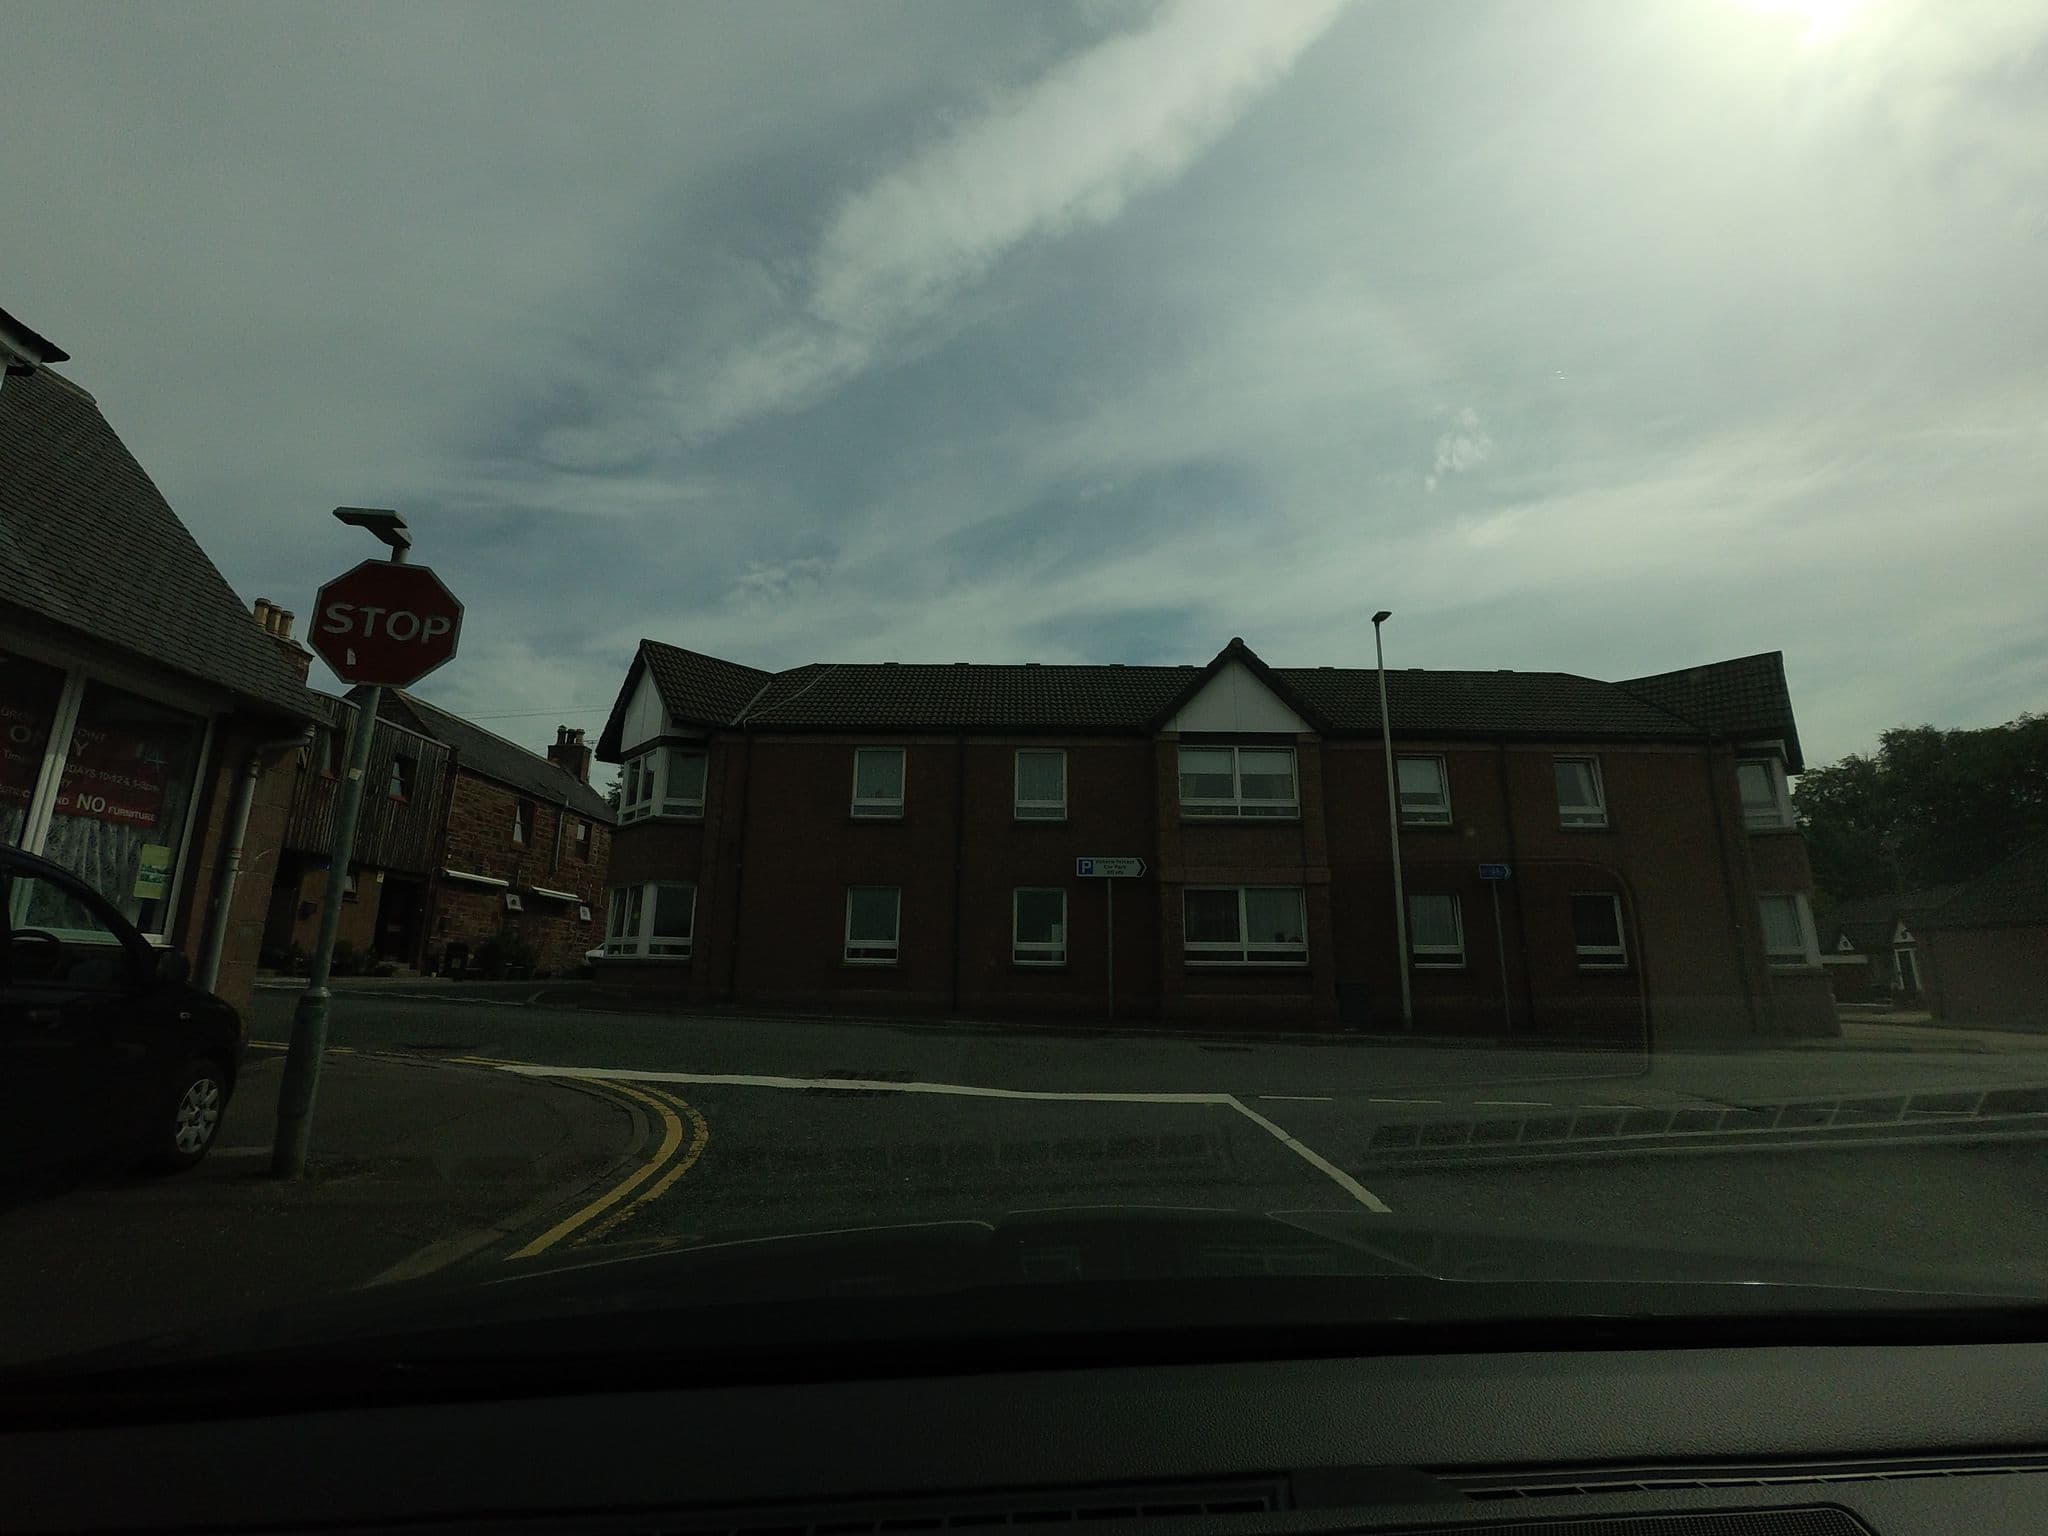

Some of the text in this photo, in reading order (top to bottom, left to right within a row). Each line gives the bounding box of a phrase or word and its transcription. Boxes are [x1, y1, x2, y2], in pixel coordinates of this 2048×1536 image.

[322, 601, 451, 644] STOP
[76, 793, 106, 812] NO
[108, 806, 157, 822] FURNITURE
